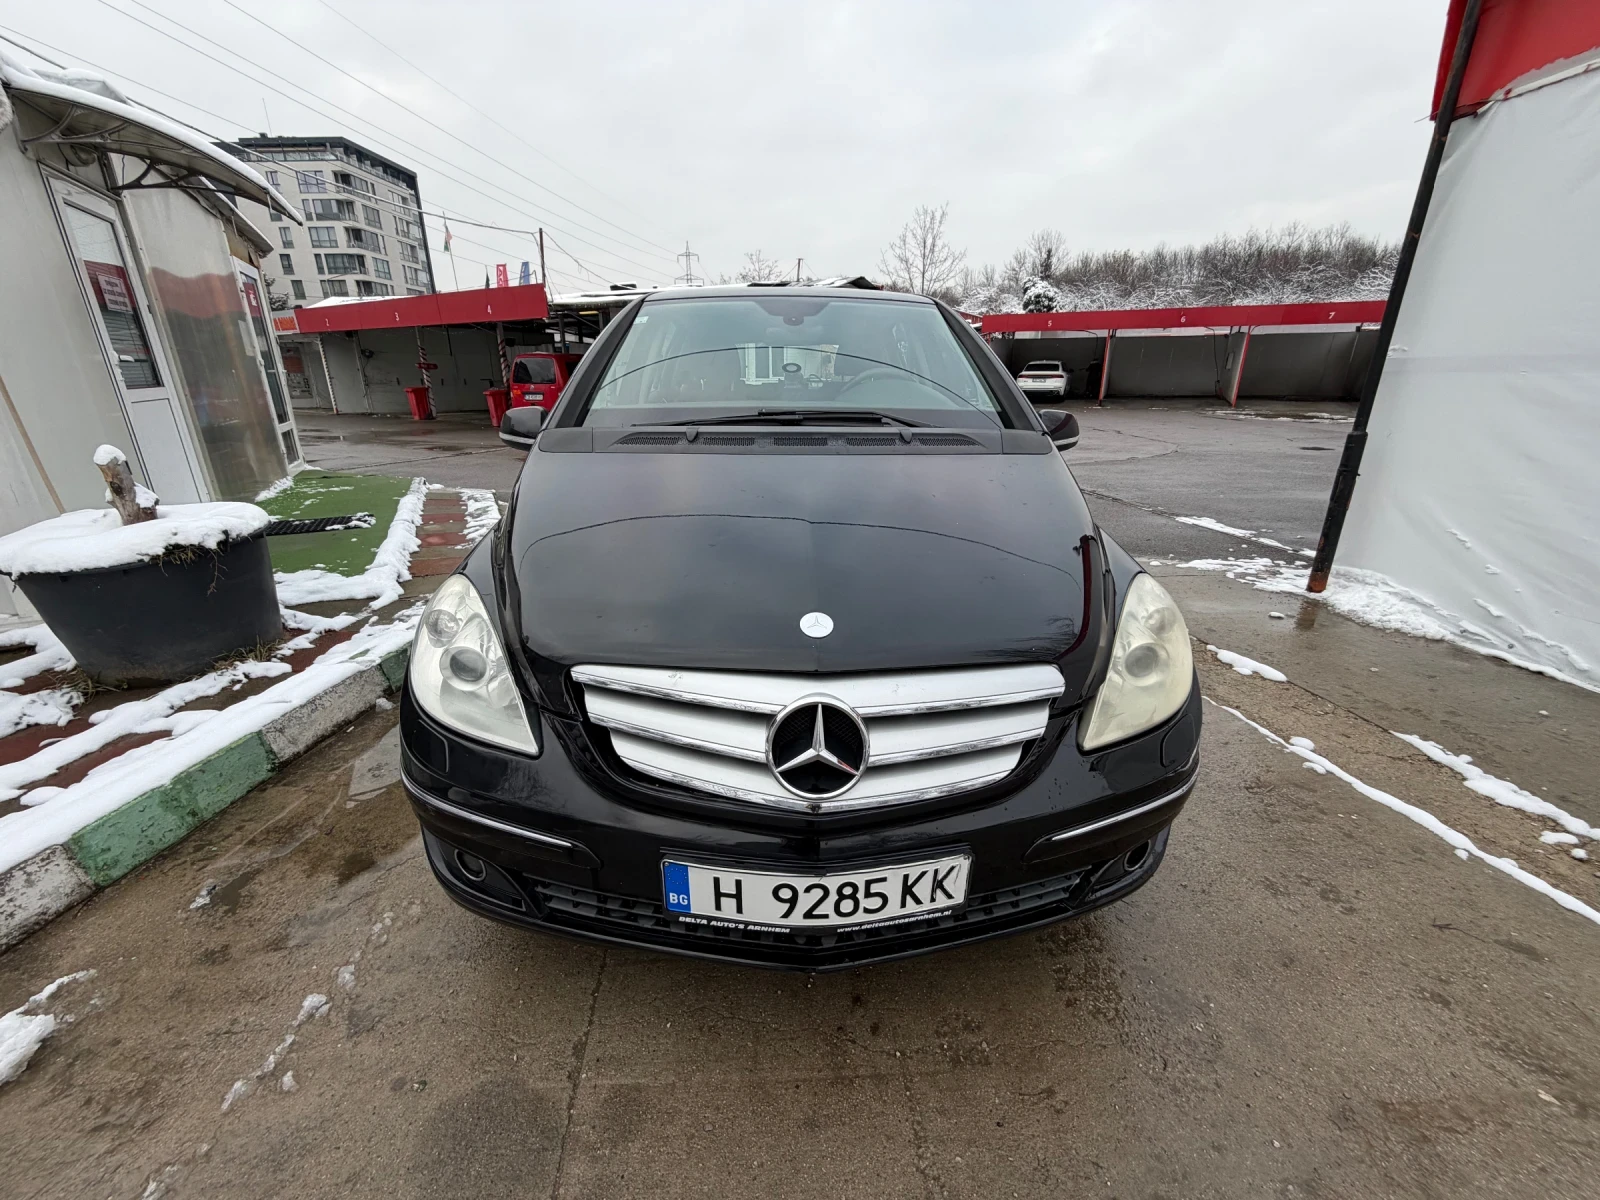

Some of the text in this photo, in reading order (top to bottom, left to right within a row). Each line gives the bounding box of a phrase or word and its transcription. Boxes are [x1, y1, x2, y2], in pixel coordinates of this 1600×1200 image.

[487, 304, 492, 315] 4
[394, 311, 400, 322] 3
[1180, 315, 1187, 323] 6
[1328, 311, 1337, 320] 7
[1047, 319, 1053, 327] 5
[713, 864, 957, 920] H 9285 KK
[669, 892, 689, 906] BG
[678, 916, 791, 934] DELTA AUTO'S ARNHEM
[836, 909, 953, 933] www.deltaautosarnhem.nl
